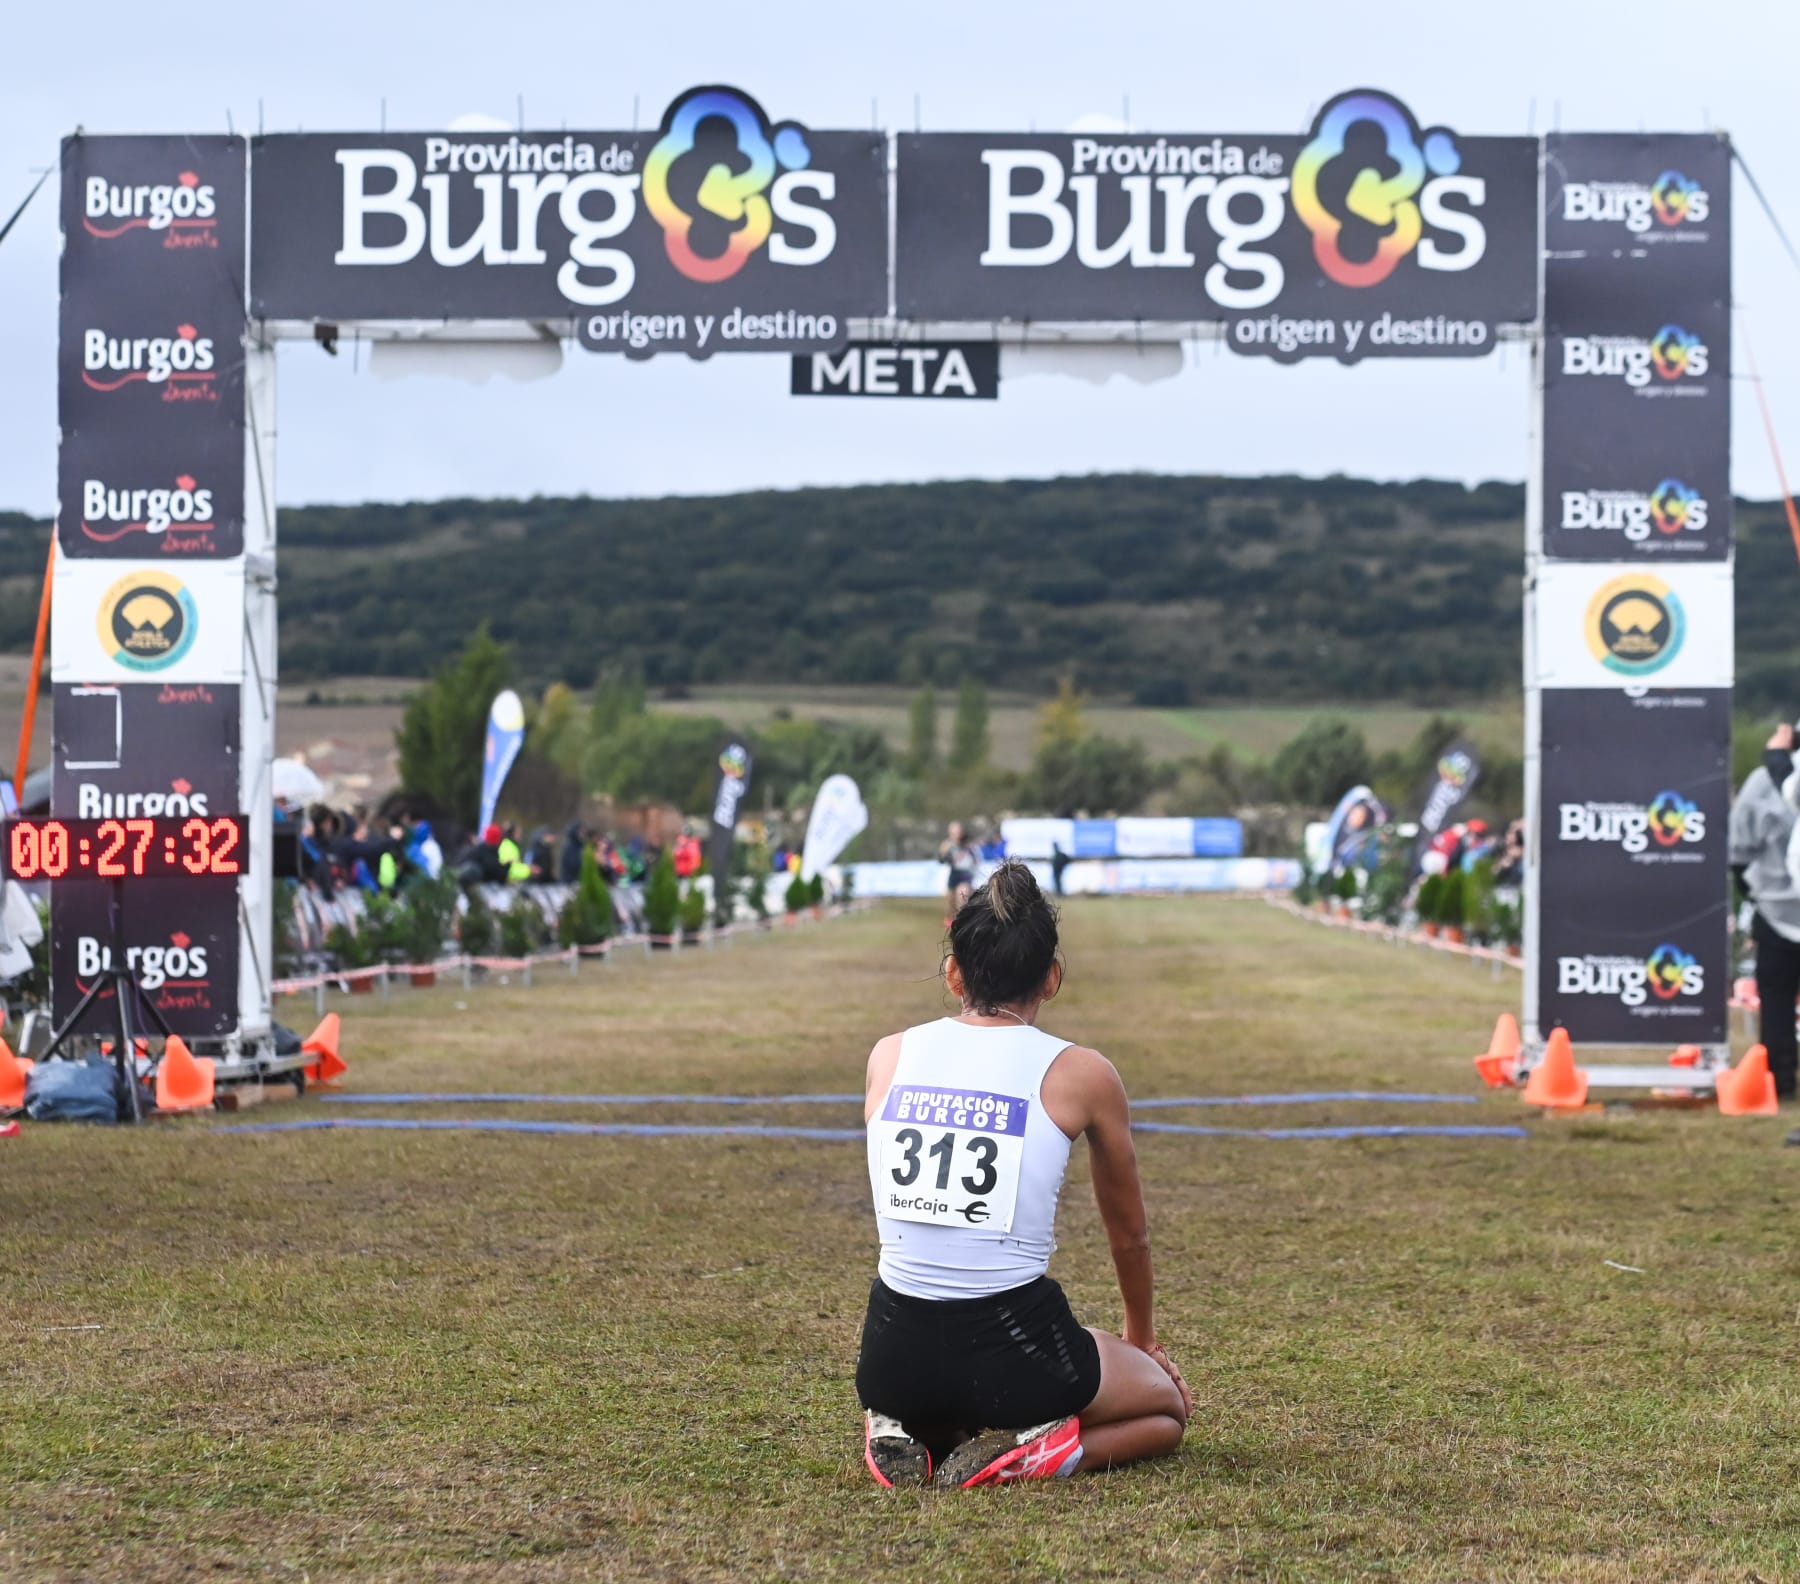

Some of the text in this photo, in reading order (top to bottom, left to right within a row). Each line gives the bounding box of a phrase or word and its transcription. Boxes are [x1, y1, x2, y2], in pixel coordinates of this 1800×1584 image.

[426, 136, 633, 172] Provincia de
[1072, 139, 1283, 175] Provincia de
[86, 175, 215, 230] Burgos
[334, 90, 836, 305] Burgos
[980, 94, 1486, 309] Burgos
[1563, 171, 1709, 232] Burgos
[587, 307, 837, 348] origen y destino
[1235, 312, 1487, 352] origen y destino
[84, 328, 214, 383] Burgos
[811, 348, 977, 396] META
[1562, 325, 1708, 387] Burgos
[83, 479, 213, 534] Burgos
[1561, 479, 1707, 541] Burgos
[11, 817, 239, 878] 00:27:32
[1559, 790, 1706, 853] Burgos
[1557, 944, 1704, 1006] Burgos
[896, 1105, 1009, 1131] BURGOS
[901, 1091, 1010, 1116] DIPUTACIÓN
[891, 1128, 999, 1196] 313
[890, 1194, 949, 1216] iberCaja
